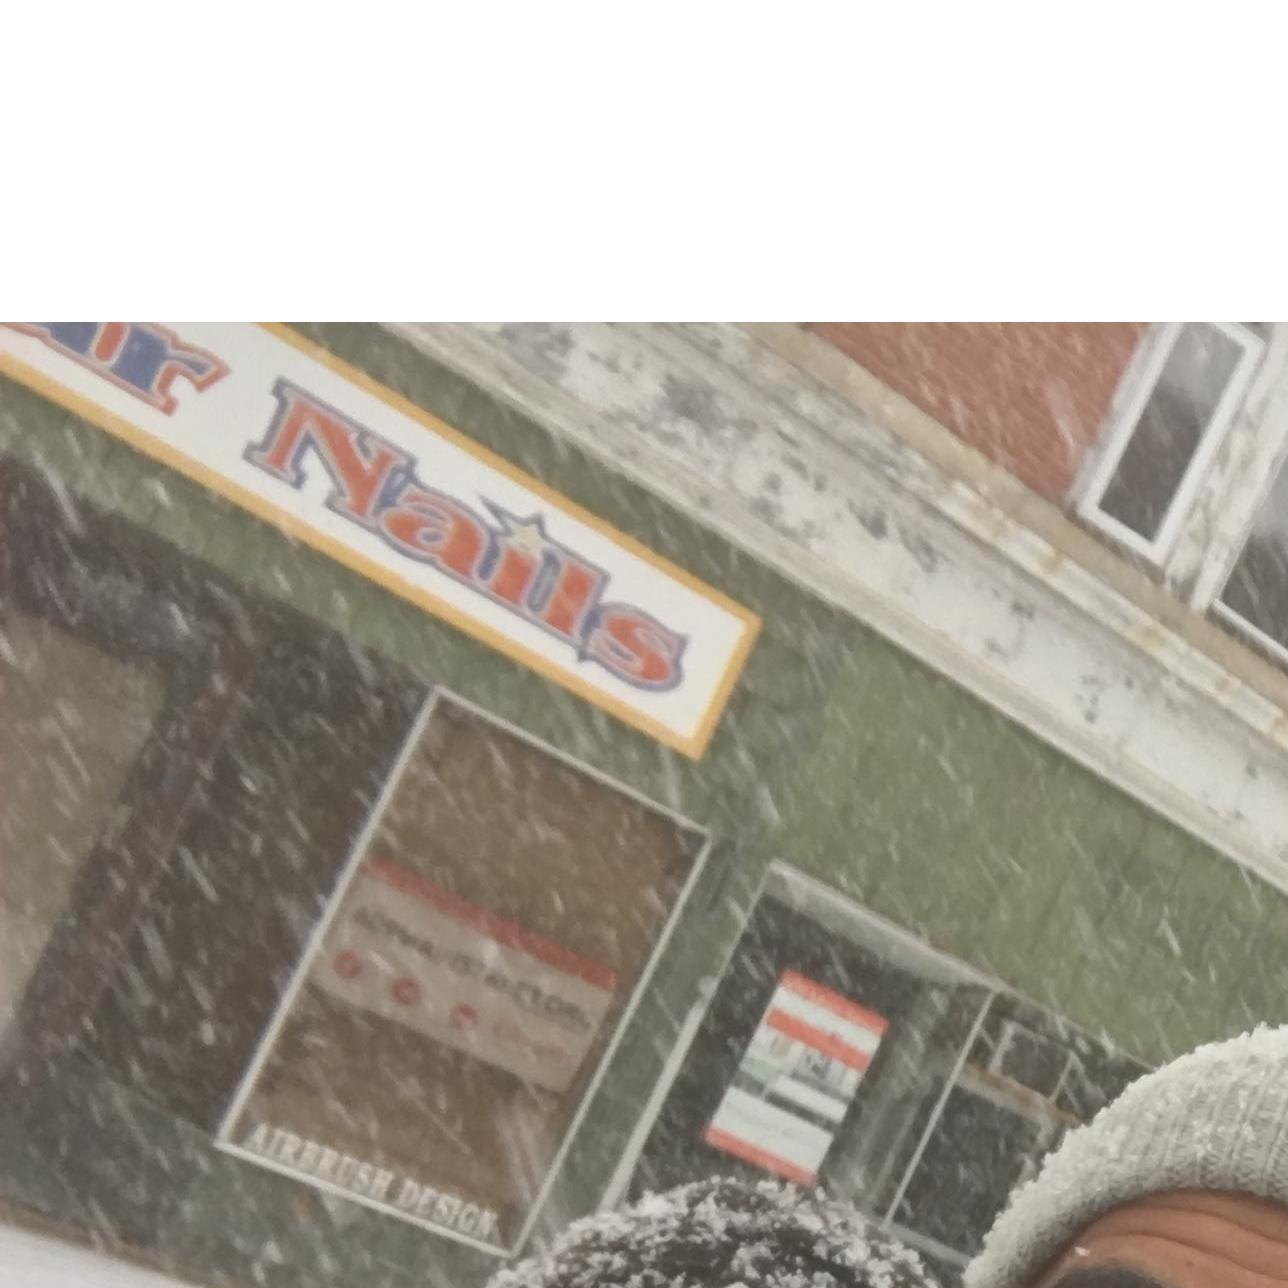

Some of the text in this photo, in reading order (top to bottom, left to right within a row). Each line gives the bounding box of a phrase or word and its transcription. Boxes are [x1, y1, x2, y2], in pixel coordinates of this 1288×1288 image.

[242, 376, 689, 693] Nails
[248, 1122, 498, 1241] AIRBRUSH DESIGN
